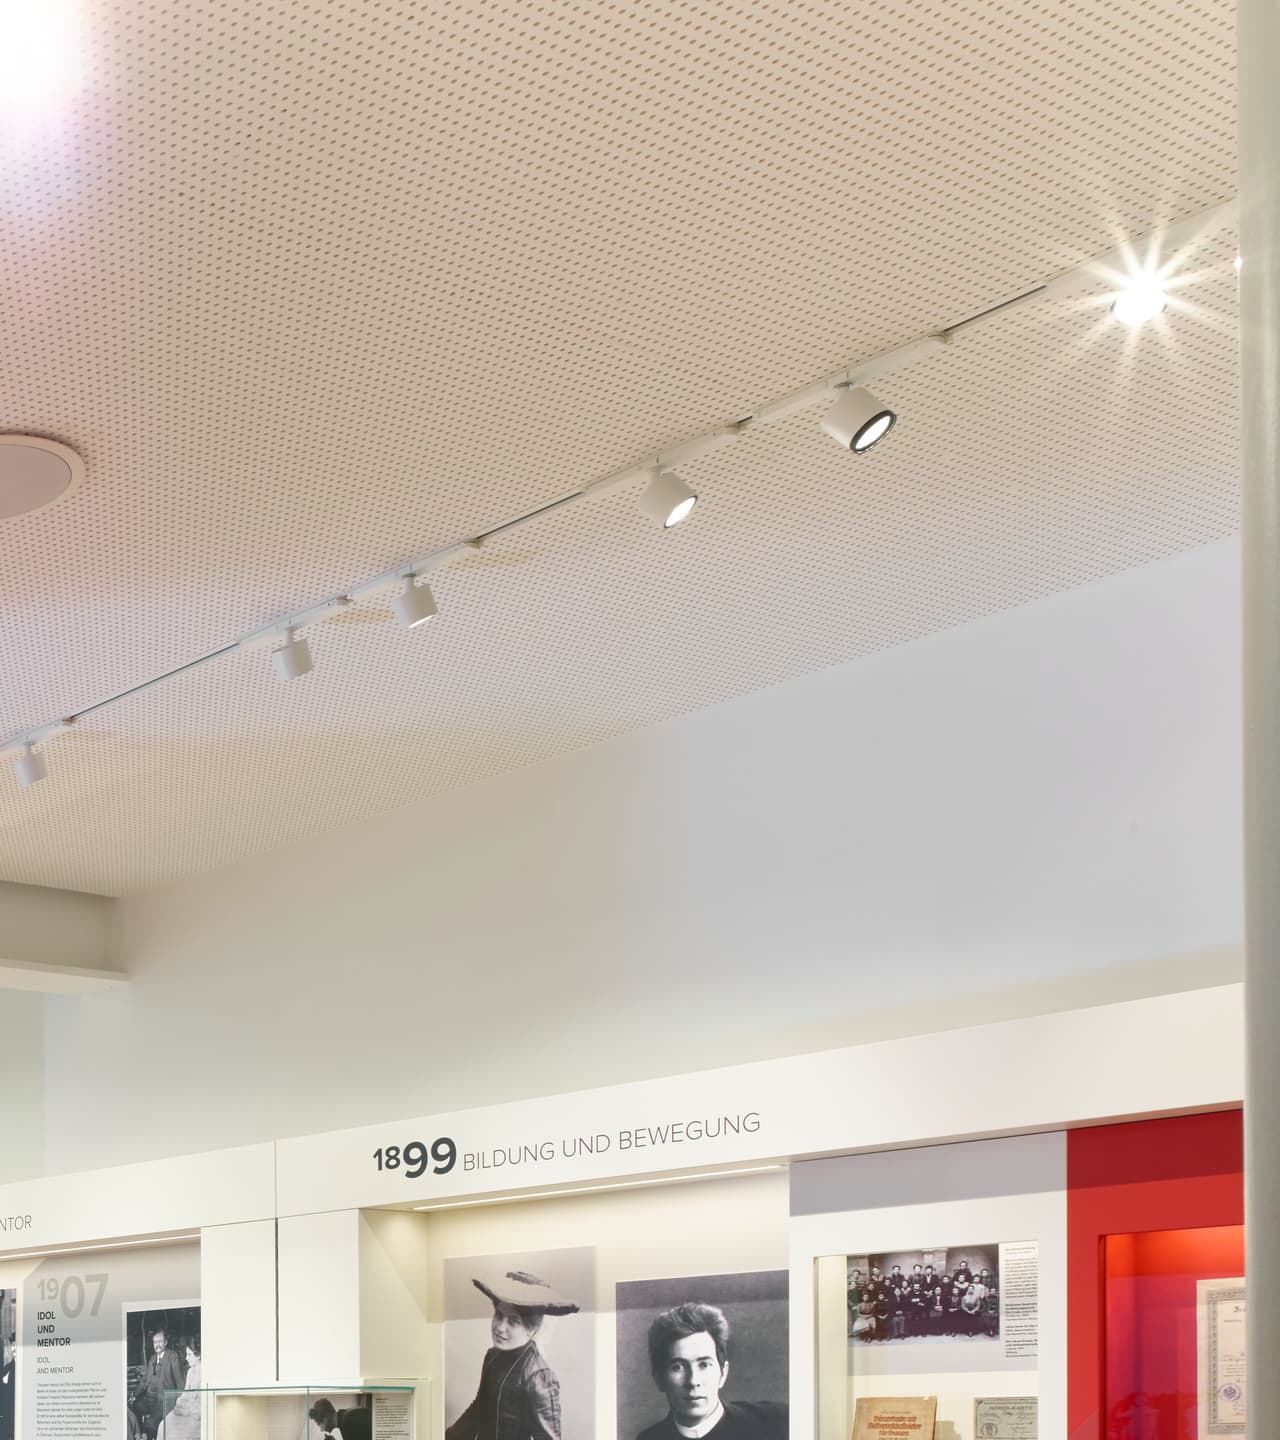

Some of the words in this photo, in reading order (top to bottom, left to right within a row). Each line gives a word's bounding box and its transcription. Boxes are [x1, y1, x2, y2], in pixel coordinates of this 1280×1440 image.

[372, 1136, 457, 1178] 1899
[463, 1141, 555, 1172] BILDUNG
[562, 1132, 611, 1159] UND
[618, 1111, 762, 1150] BEWEGUNG
[37, 1273, 109, 1319] 1907
[37, 1311, 56, 1320] IDOL
[37, 1324, 55, 1334] UND
[37, 1337, 71, 1348] MENTOR
